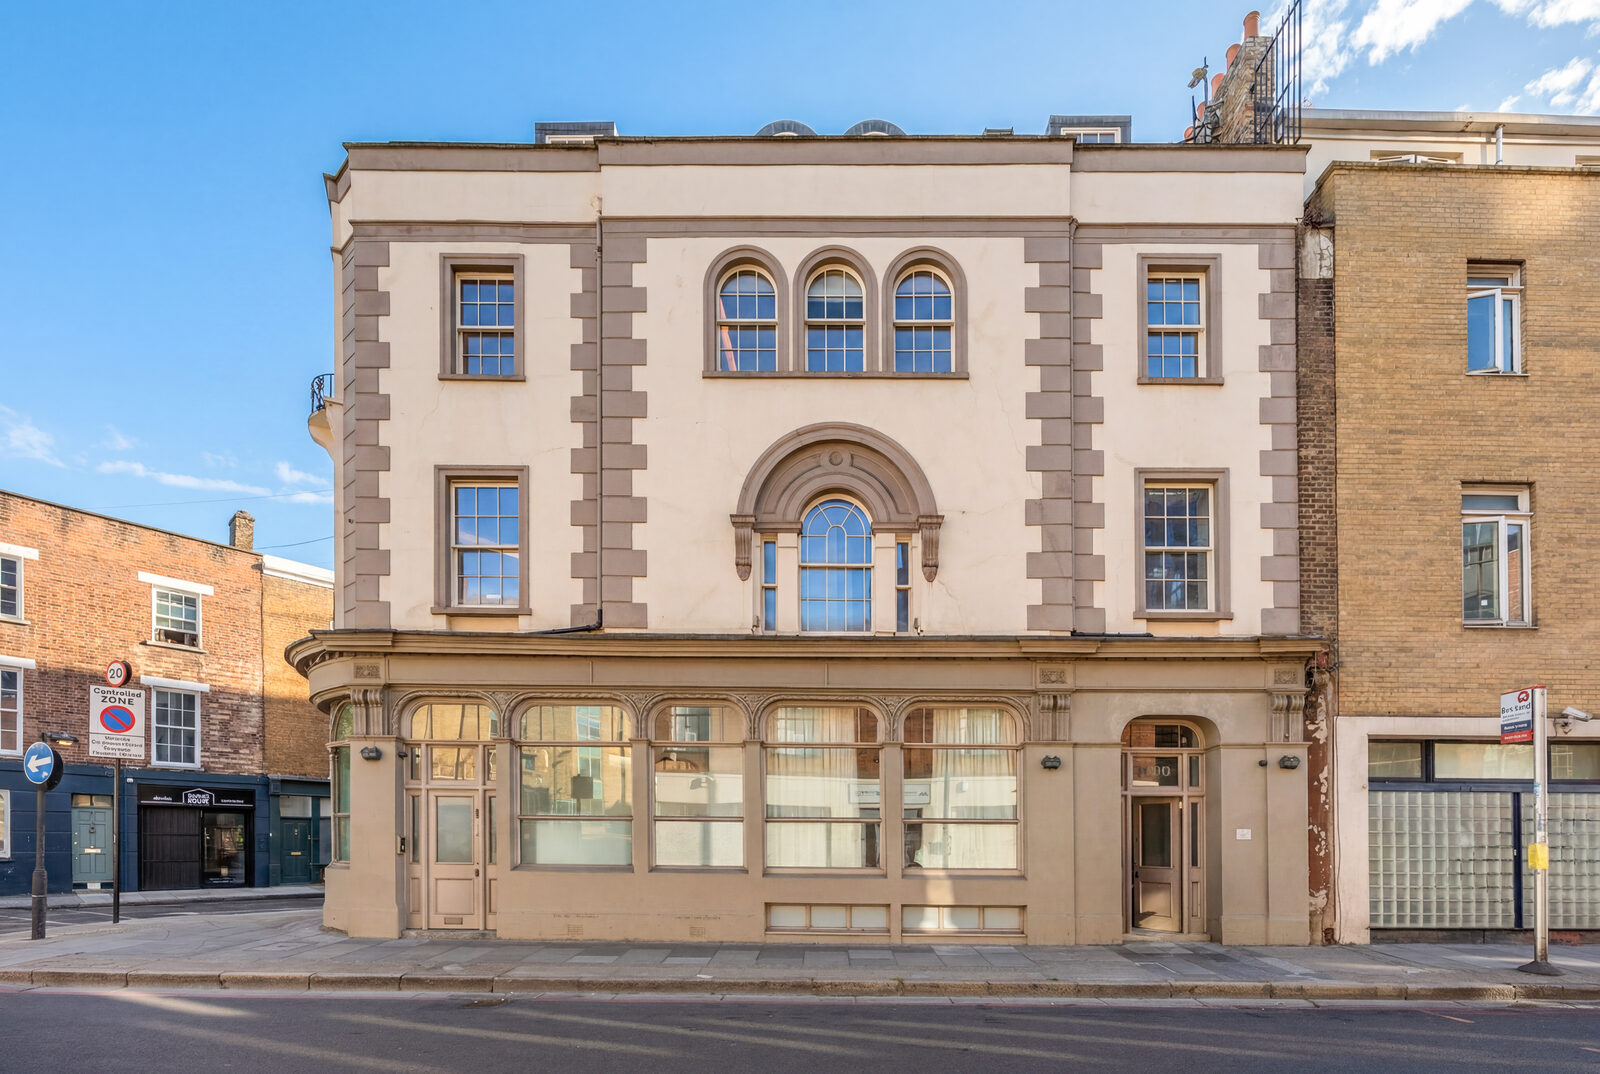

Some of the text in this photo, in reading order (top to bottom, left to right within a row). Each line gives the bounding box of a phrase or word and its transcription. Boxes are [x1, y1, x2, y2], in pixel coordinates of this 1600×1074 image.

[109, 667, 123, 679] 20
[93, 687, 142, 698] Controlled
[101, 695, 135, 706] ZONE
